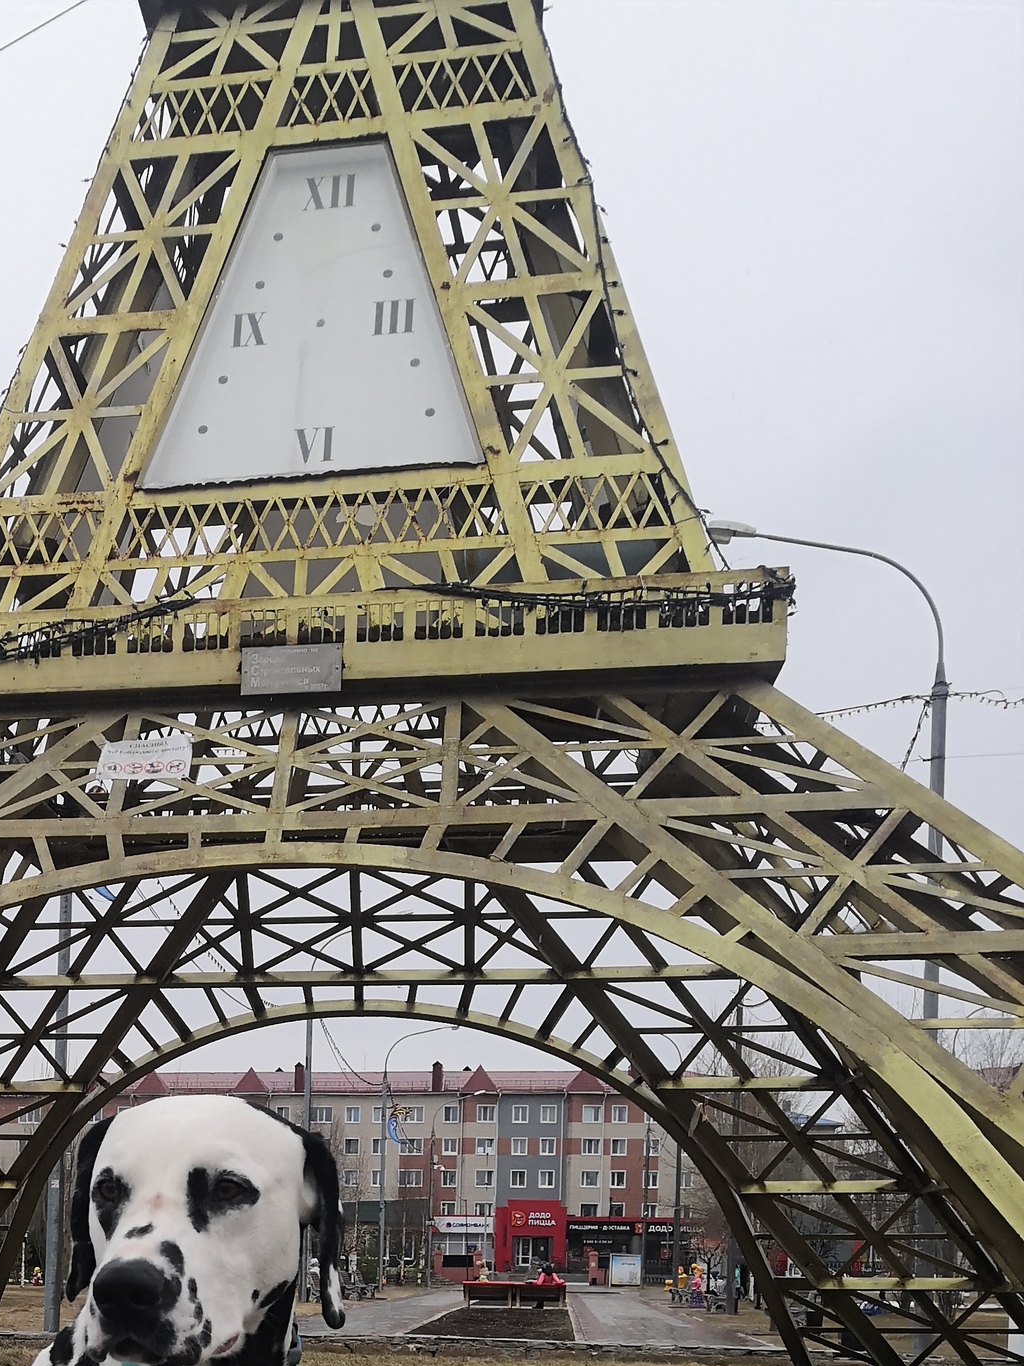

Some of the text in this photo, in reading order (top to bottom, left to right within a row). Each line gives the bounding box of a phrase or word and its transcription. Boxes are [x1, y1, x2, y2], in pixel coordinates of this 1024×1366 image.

[304, 174, 357, 210] XII
[231, 311, 267, 348] IX
[371, 298, 417, 336] III
[294, 426, 336, 464] VI
[648, 1225, 673, 1233] ДОДО
